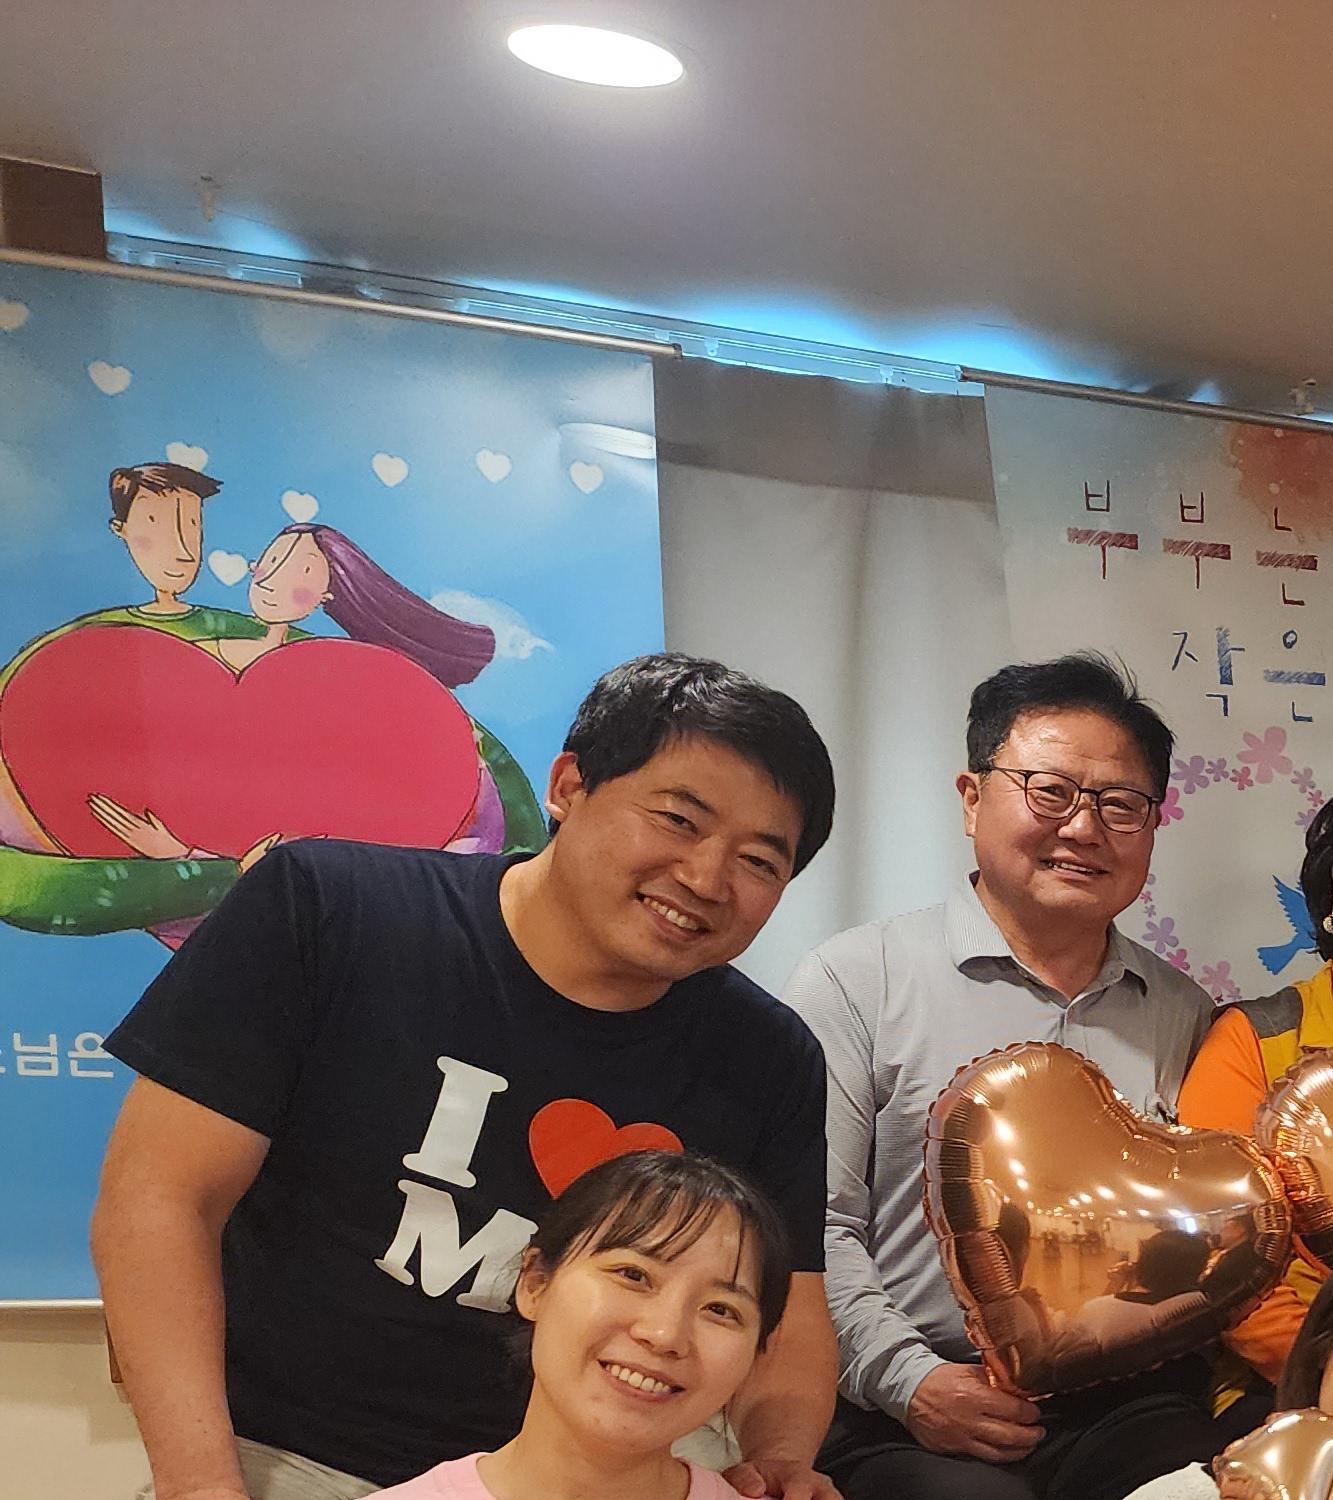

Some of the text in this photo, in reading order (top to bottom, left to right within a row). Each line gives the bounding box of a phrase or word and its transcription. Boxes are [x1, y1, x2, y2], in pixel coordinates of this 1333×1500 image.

[0, 1031, 116, 1078] 님은
[402, 1056, 508, 1188] I
[374, 1179, 539, 1313] M
